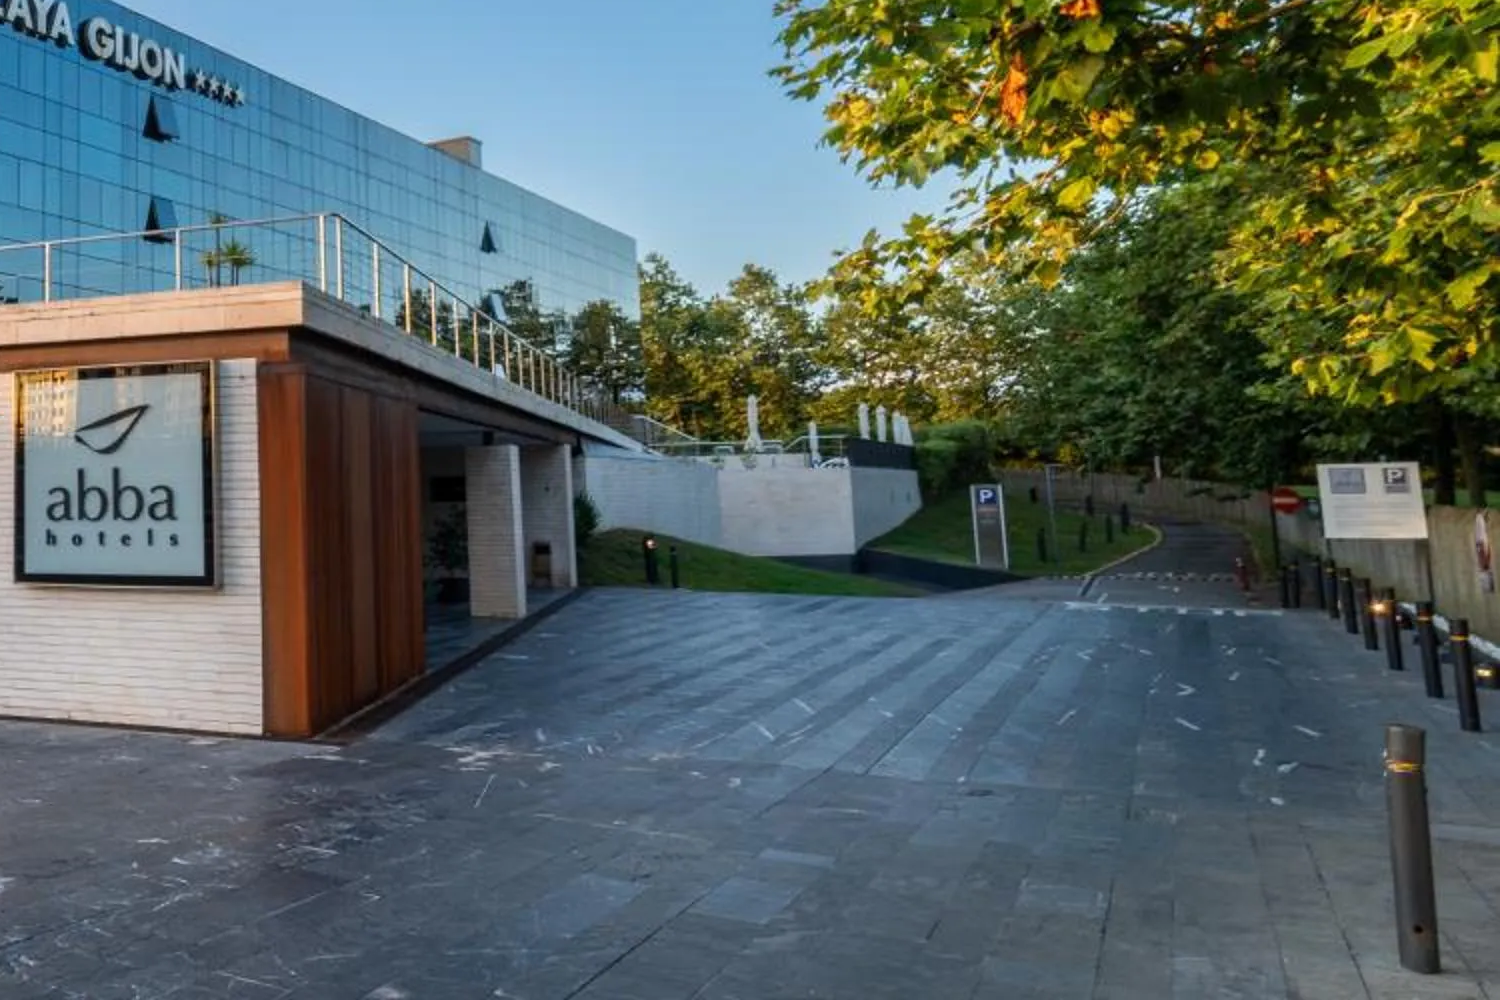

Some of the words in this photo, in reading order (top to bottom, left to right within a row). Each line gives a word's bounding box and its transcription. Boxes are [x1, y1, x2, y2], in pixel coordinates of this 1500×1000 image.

[83, 16, 185, 89] GIJON
[1386, 468, 1403, 484] P
[46, 466, 178, 522] abba
[979, 489, 993, 504] P
[45, 528, 179, 547] hotels
